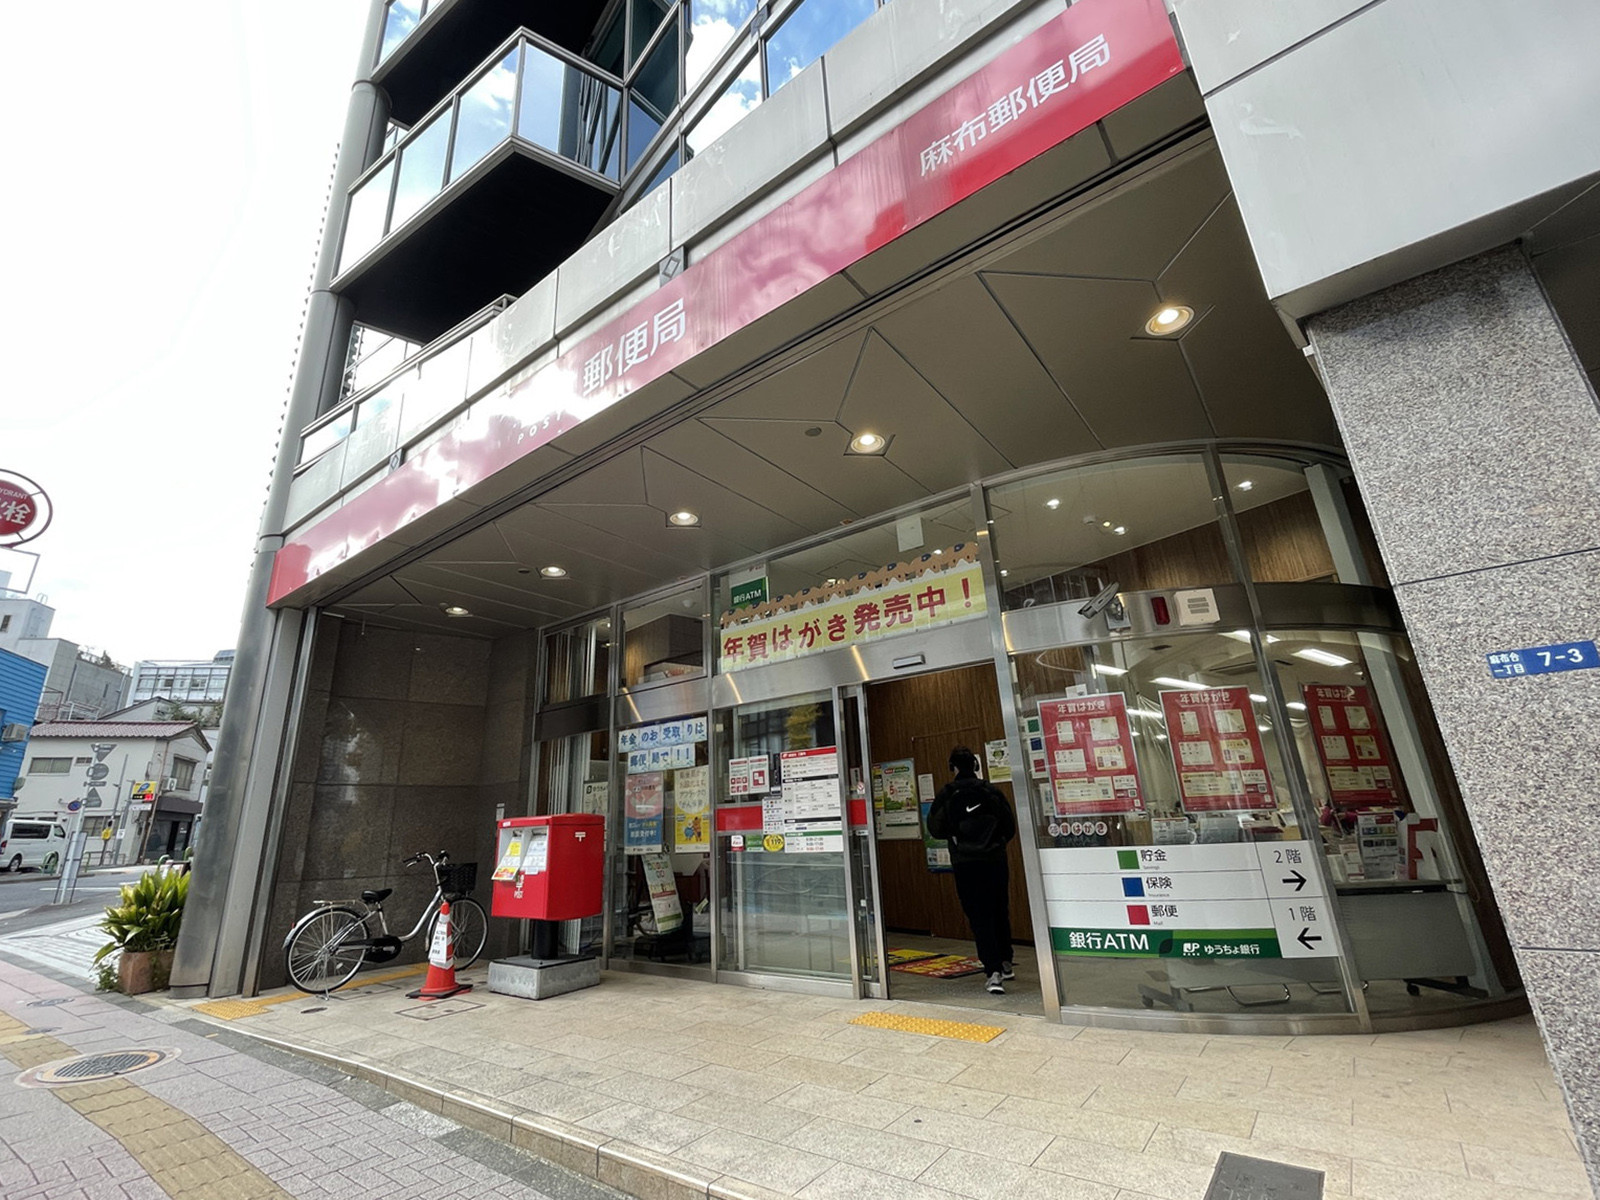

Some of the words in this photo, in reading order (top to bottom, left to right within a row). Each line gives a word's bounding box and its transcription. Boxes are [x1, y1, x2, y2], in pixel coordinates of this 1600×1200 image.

[919, 33, 1111, 177] 麻布郵便局
[583, 297, 686, 397] 郵便局
[0, 501, 31, 525] 栓
[733, 589, 762, 604] 銀行ATM
[1536, 648, 1584, 667] 7-3
[1494, 663, 1525, 675] 一丁目
[1180, 690, 1231, 704] 年賀はがき
[1057, 700, 1106, 714] 年賀はがき
[1140, 849, 1168, 862] 貯金
[1273, 848, 1302, 865] 2階
[1146, 876, 1173, 889] 保険
[1151, 904, 1179, 918] 郵便
[1288, 906, 1316, 922] 1階
[1069, 932, 1150, 952] 銀行ATM
[1204, 944, 1260, 955] ゆうちょ銀行
